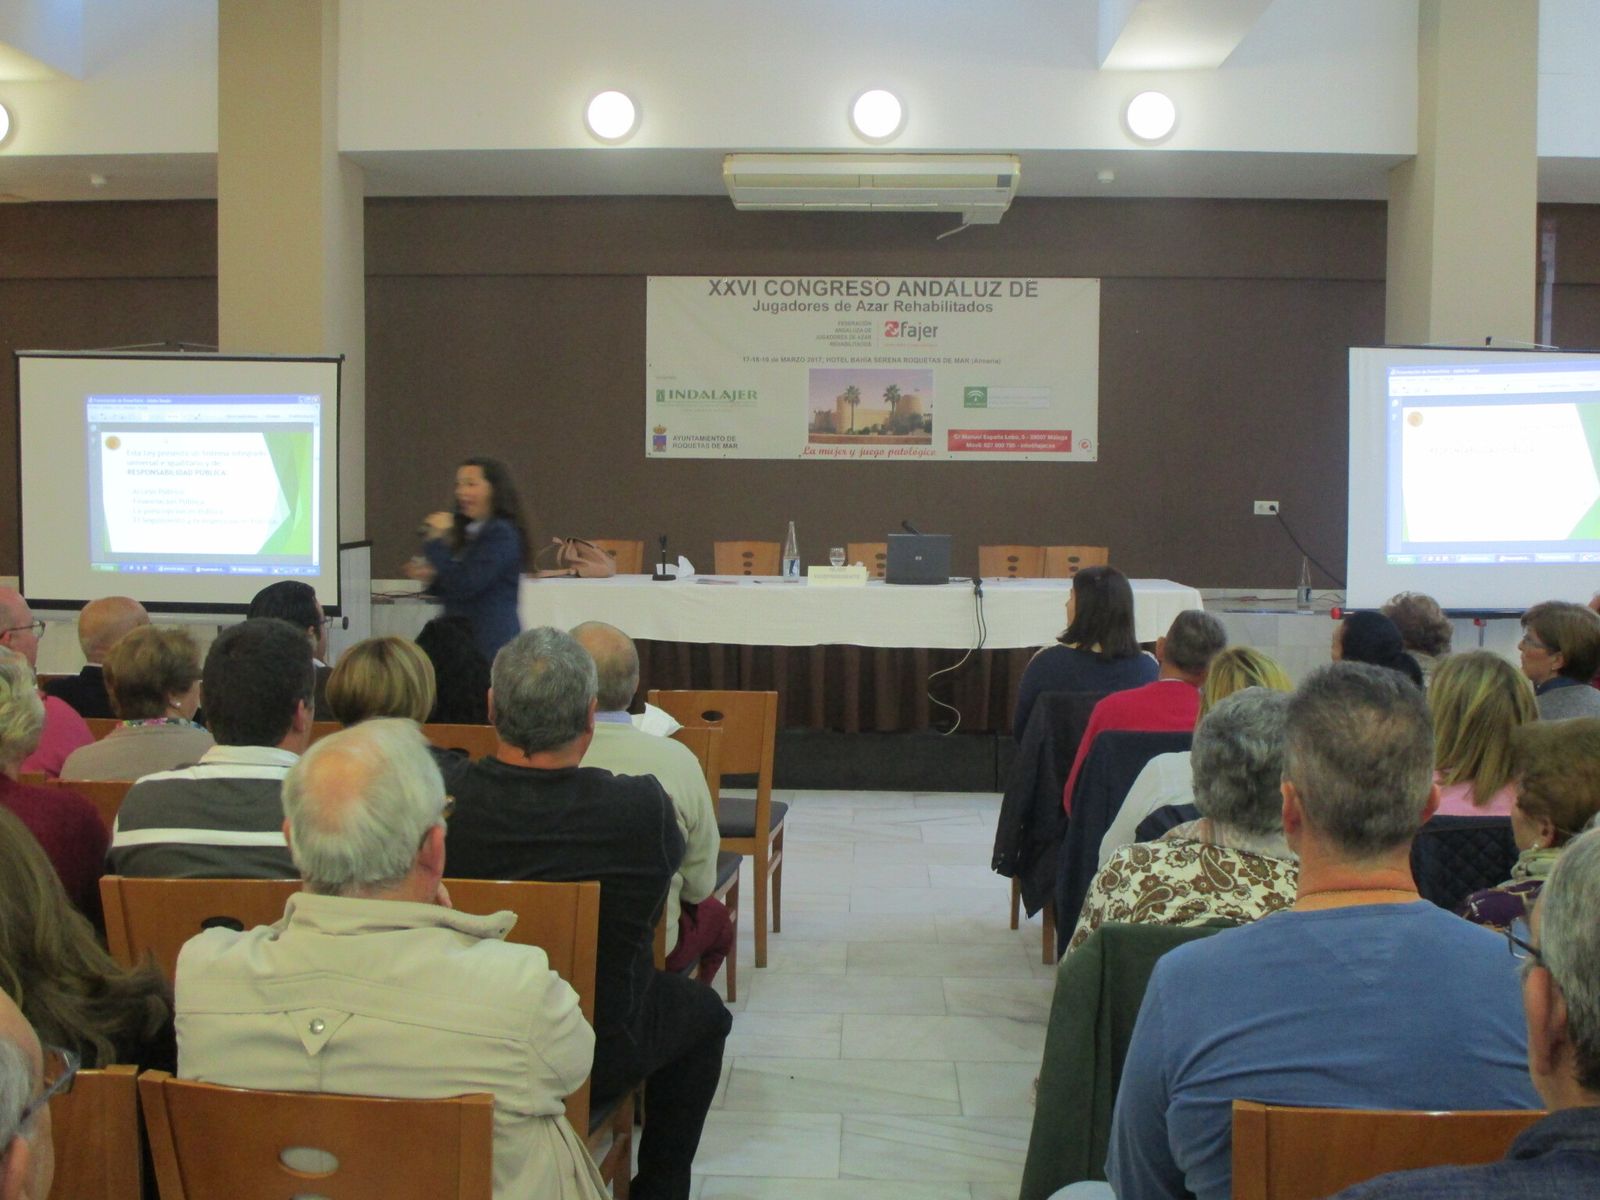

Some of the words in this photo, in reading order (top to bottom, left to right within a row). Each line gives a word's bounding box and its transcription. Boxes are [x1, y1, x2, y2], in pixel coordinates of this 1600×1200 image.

[708, 279, 757, 297] XXVI
[764, 279, 891, 297] CONGRESO
[1009, 280, 1039, 298] DE
[752, 300, 830, 315] Jugadores
[834, 300, 851, 313] de
[855, 301, 888, 313] Azar
[893, 300, 994, 313] Rehabilitados
[900, 320, 939, 341] fajer
[873, 356, 902, 364] SERENA
[903, 356, 941, 364] ROQUETAS
[668, 389, 758, 402] INDALAJER
[802, 446, 816, 455] La
[819, 447, 847, 457] mujer
[849, 448, 856, 457] y
[859, 447, 885, 458] juego
